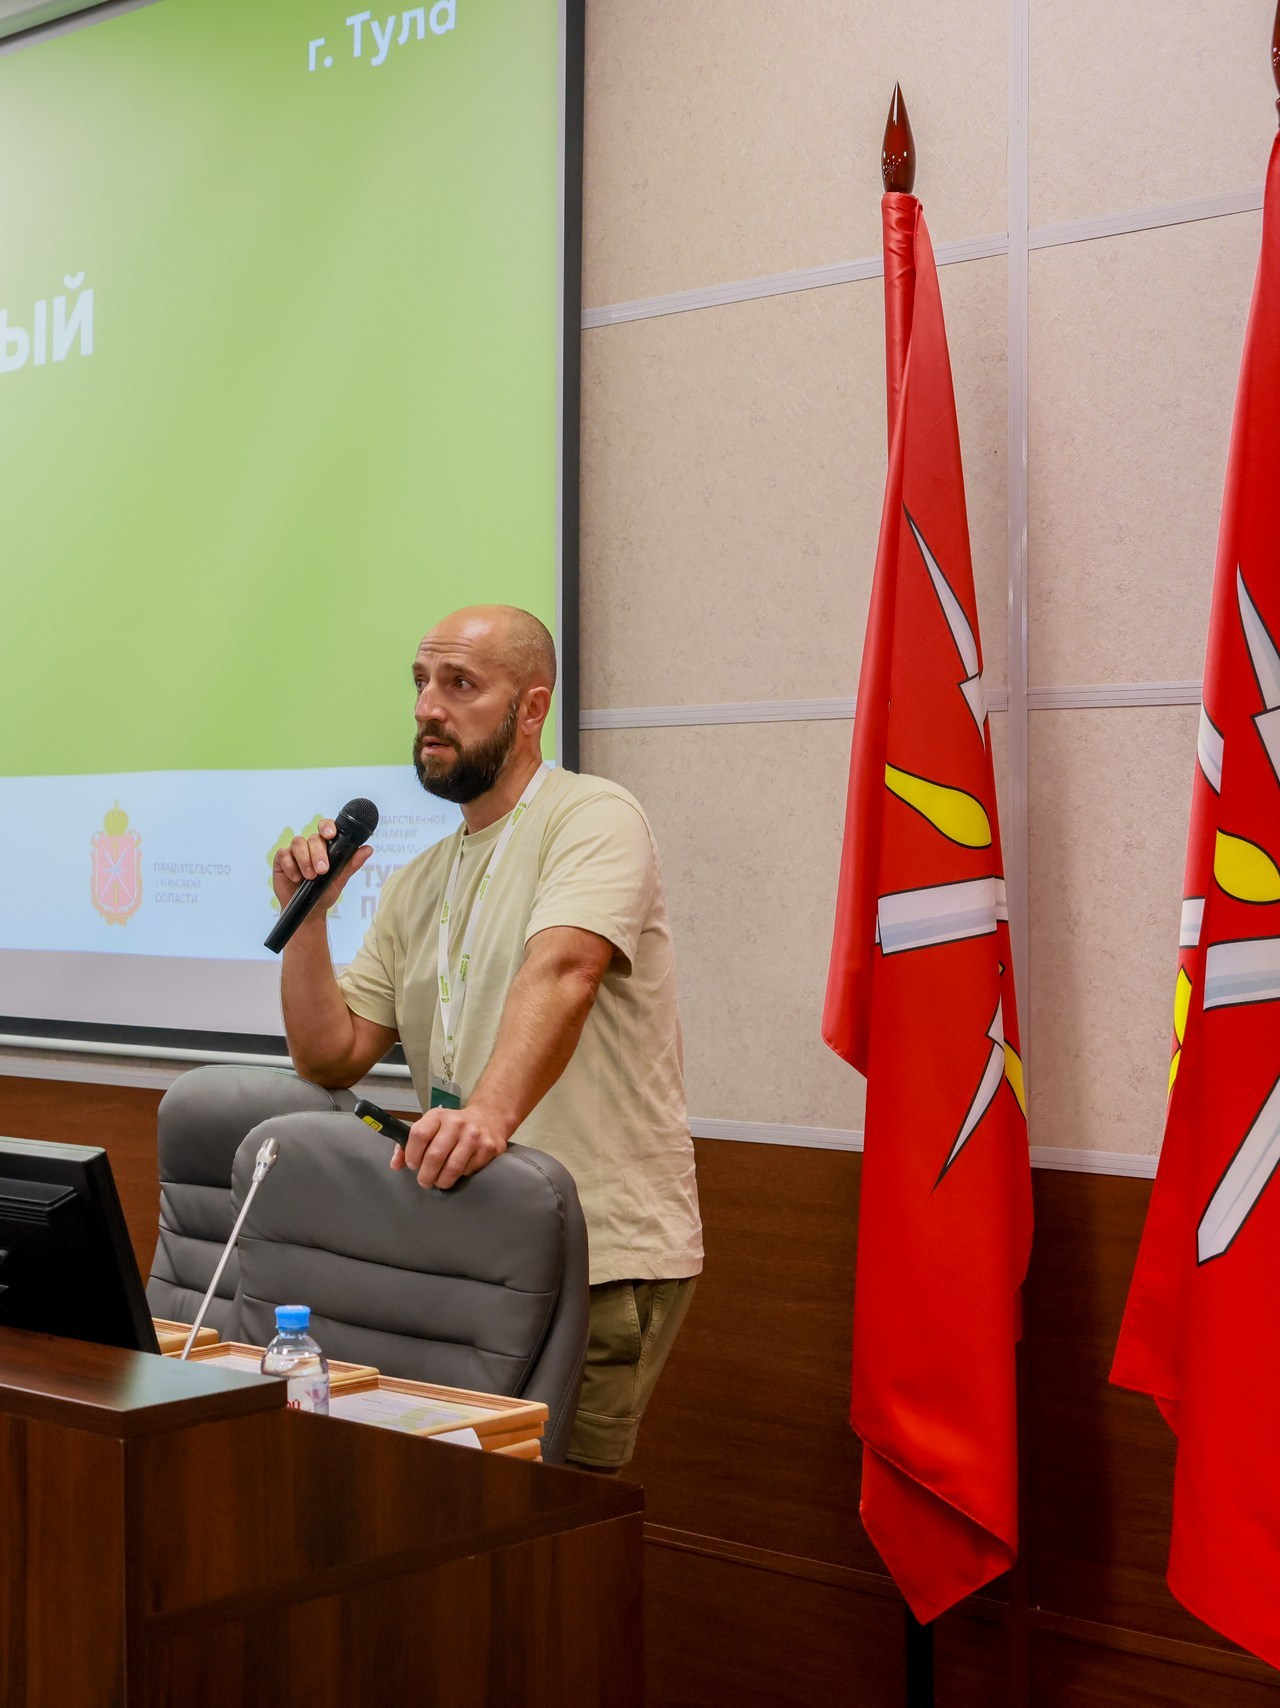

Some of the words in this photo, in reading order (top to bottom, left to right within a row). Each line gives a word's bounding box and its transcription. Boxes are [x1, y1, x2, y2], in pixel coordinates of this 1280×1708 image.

[308, 36, 333, 72] г.
[345, 0, 457, 67] Тула
[153, 862, 232, 875] ПРАВИТЕЛЬСТВО
